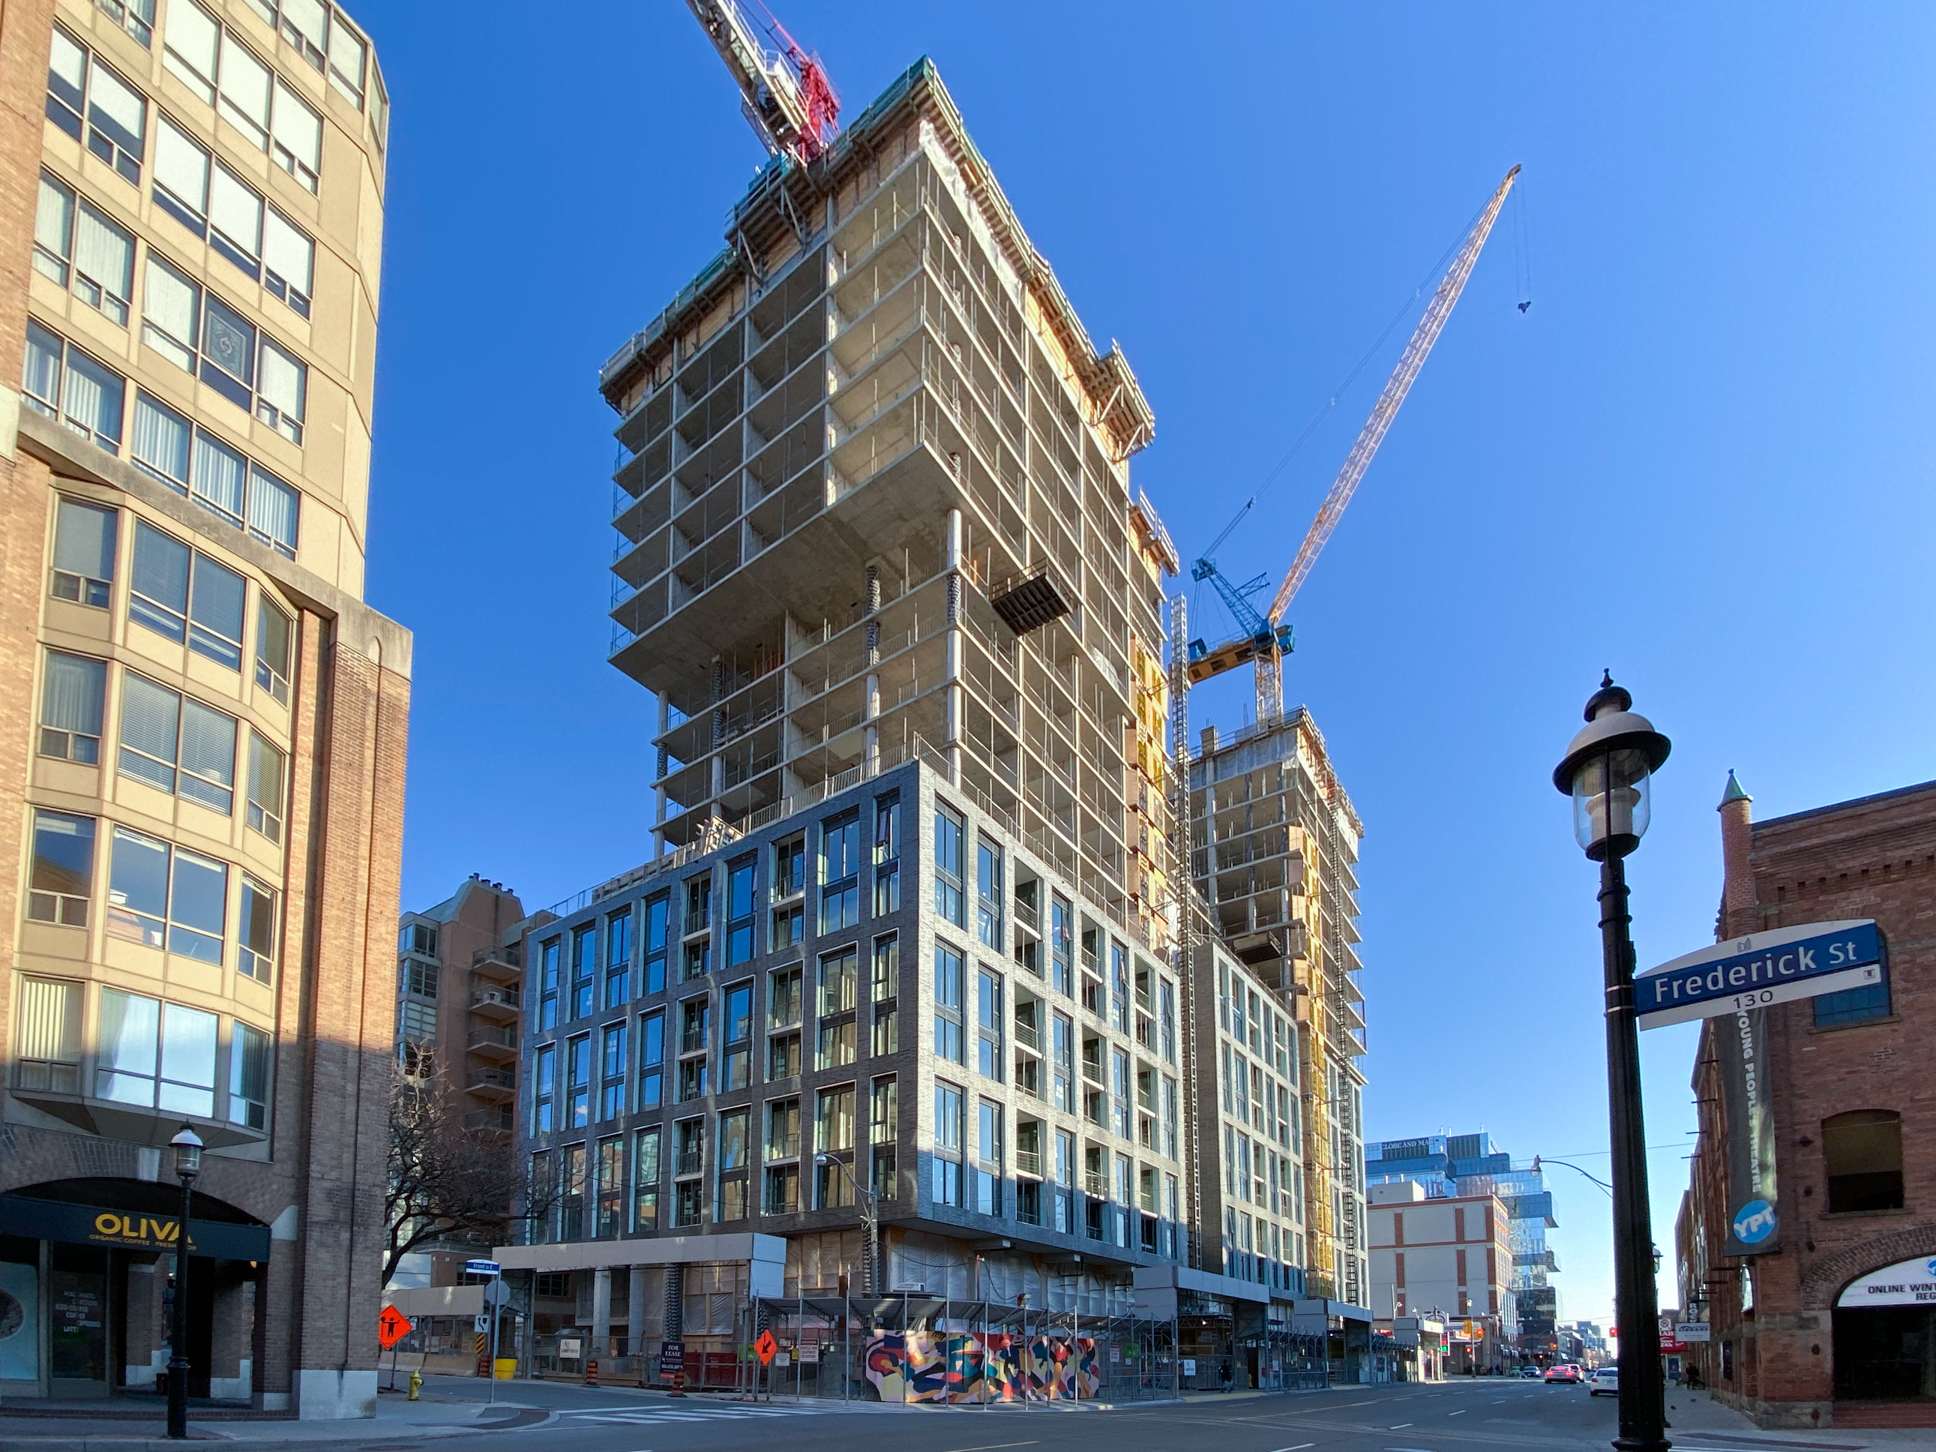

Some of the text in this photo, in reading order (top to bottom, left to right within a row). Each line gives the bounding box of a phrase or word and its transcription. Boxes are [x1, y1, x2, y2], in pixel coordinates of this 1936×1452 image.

[1655, 941, 1857, 1003] Frederick St
[1733, 990, 1773, 1009] 130
[1737, 1010, 1753, 1059] YOUNG
[1750, 1134, 1761, 1193] THEATRE
[95, 1213, 192, 1244] OLIVA
[1734, 1206, 1774, 1238] YPT
[1868, 1285, 1906, 1294] ONLINE
